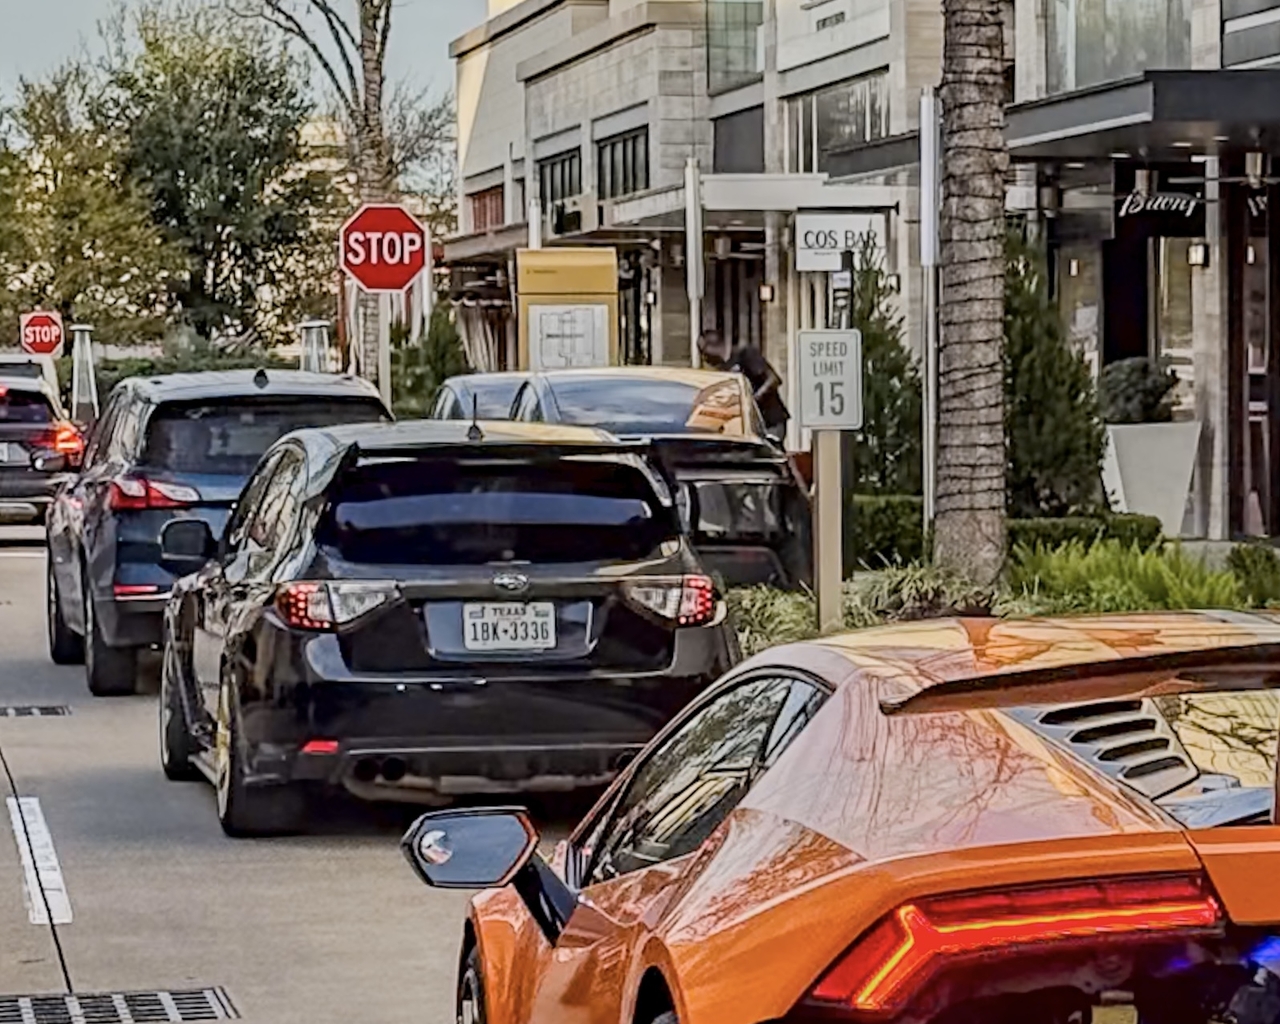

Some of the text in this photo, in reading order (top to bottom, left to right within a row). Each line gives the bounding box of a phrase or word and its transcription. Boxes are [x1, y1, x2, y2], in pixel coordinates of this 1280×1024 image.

[346, 231, 422, 265] STOP
[804, 229, 877, 249] COS BAR
[25, 325, 60, 344] STOP
[810, 341, 848, 358] SPEED
[813, 361, 845, 377] LIMIT
[814, 381, 845, 416] 15
[492, 606, 526, 617] TEXAS
